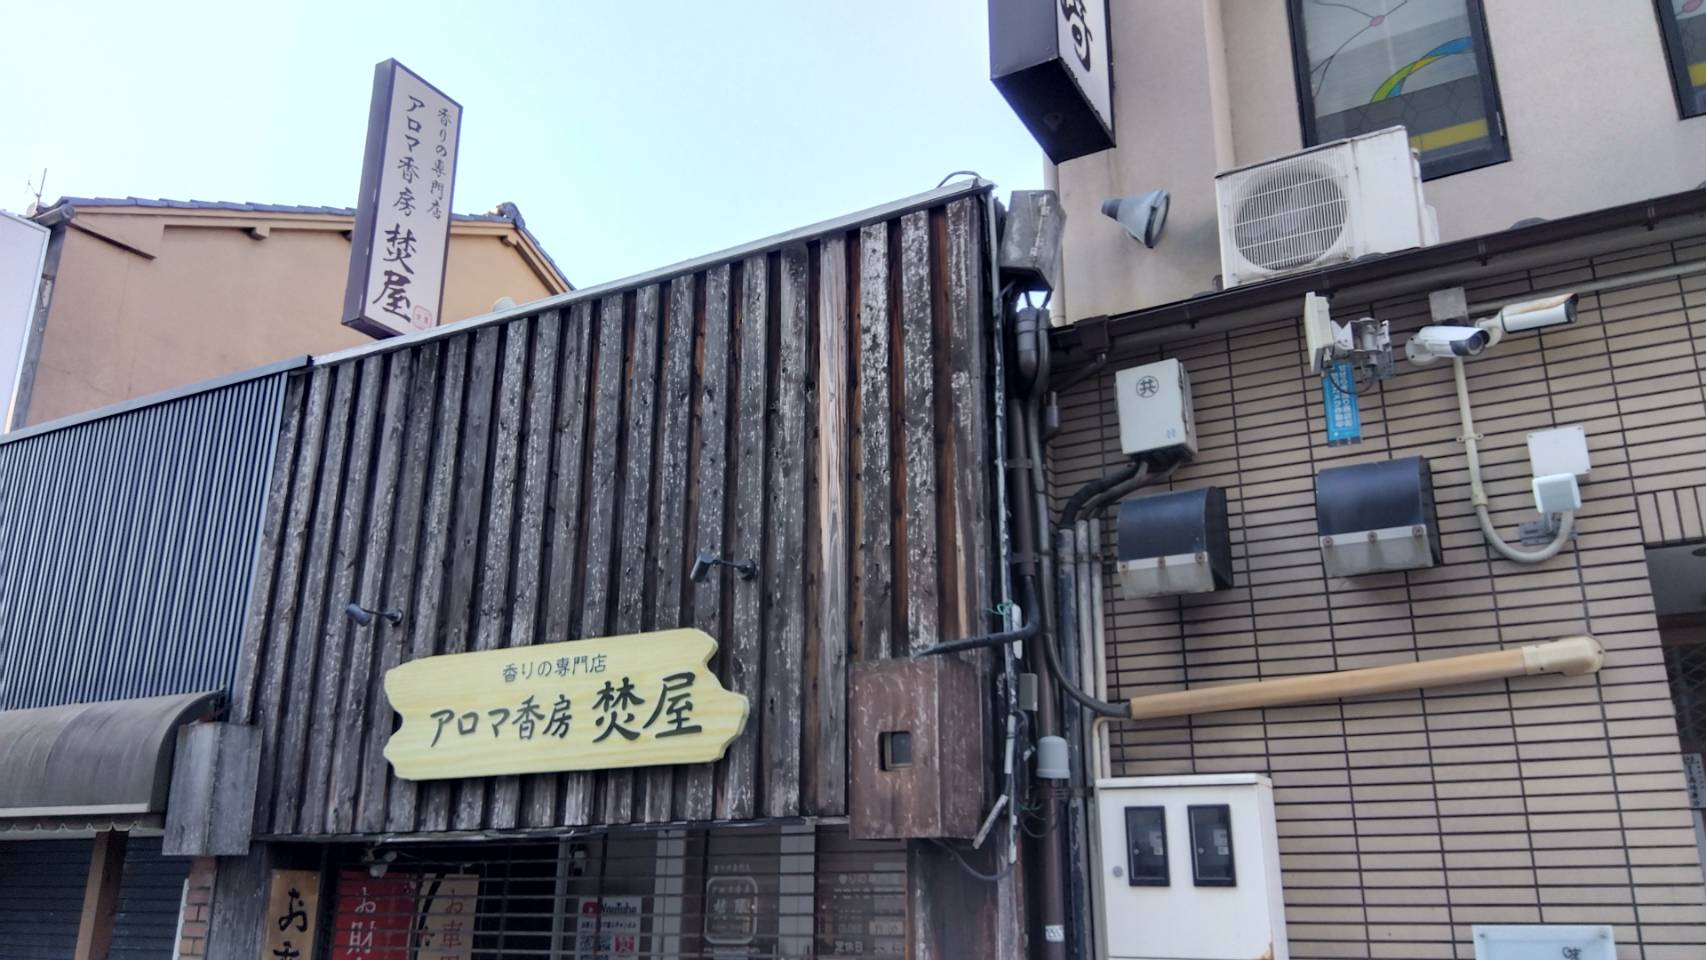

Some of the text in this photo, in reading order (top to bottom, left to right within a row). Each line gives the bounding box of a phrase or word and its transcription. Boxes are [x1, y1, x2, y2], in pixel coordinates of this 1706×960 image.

[426, 107, 453, 221] 香りの専門店
[372, 94, 426, 324] アロマ香房 焚屋
[502, 653, 608, 683] 香りの専門店
[429, 671, 702, 748] アロマ香房 焚屋
[346, 886, 377, 960] お財
[440, 887, 464, 960] お車
